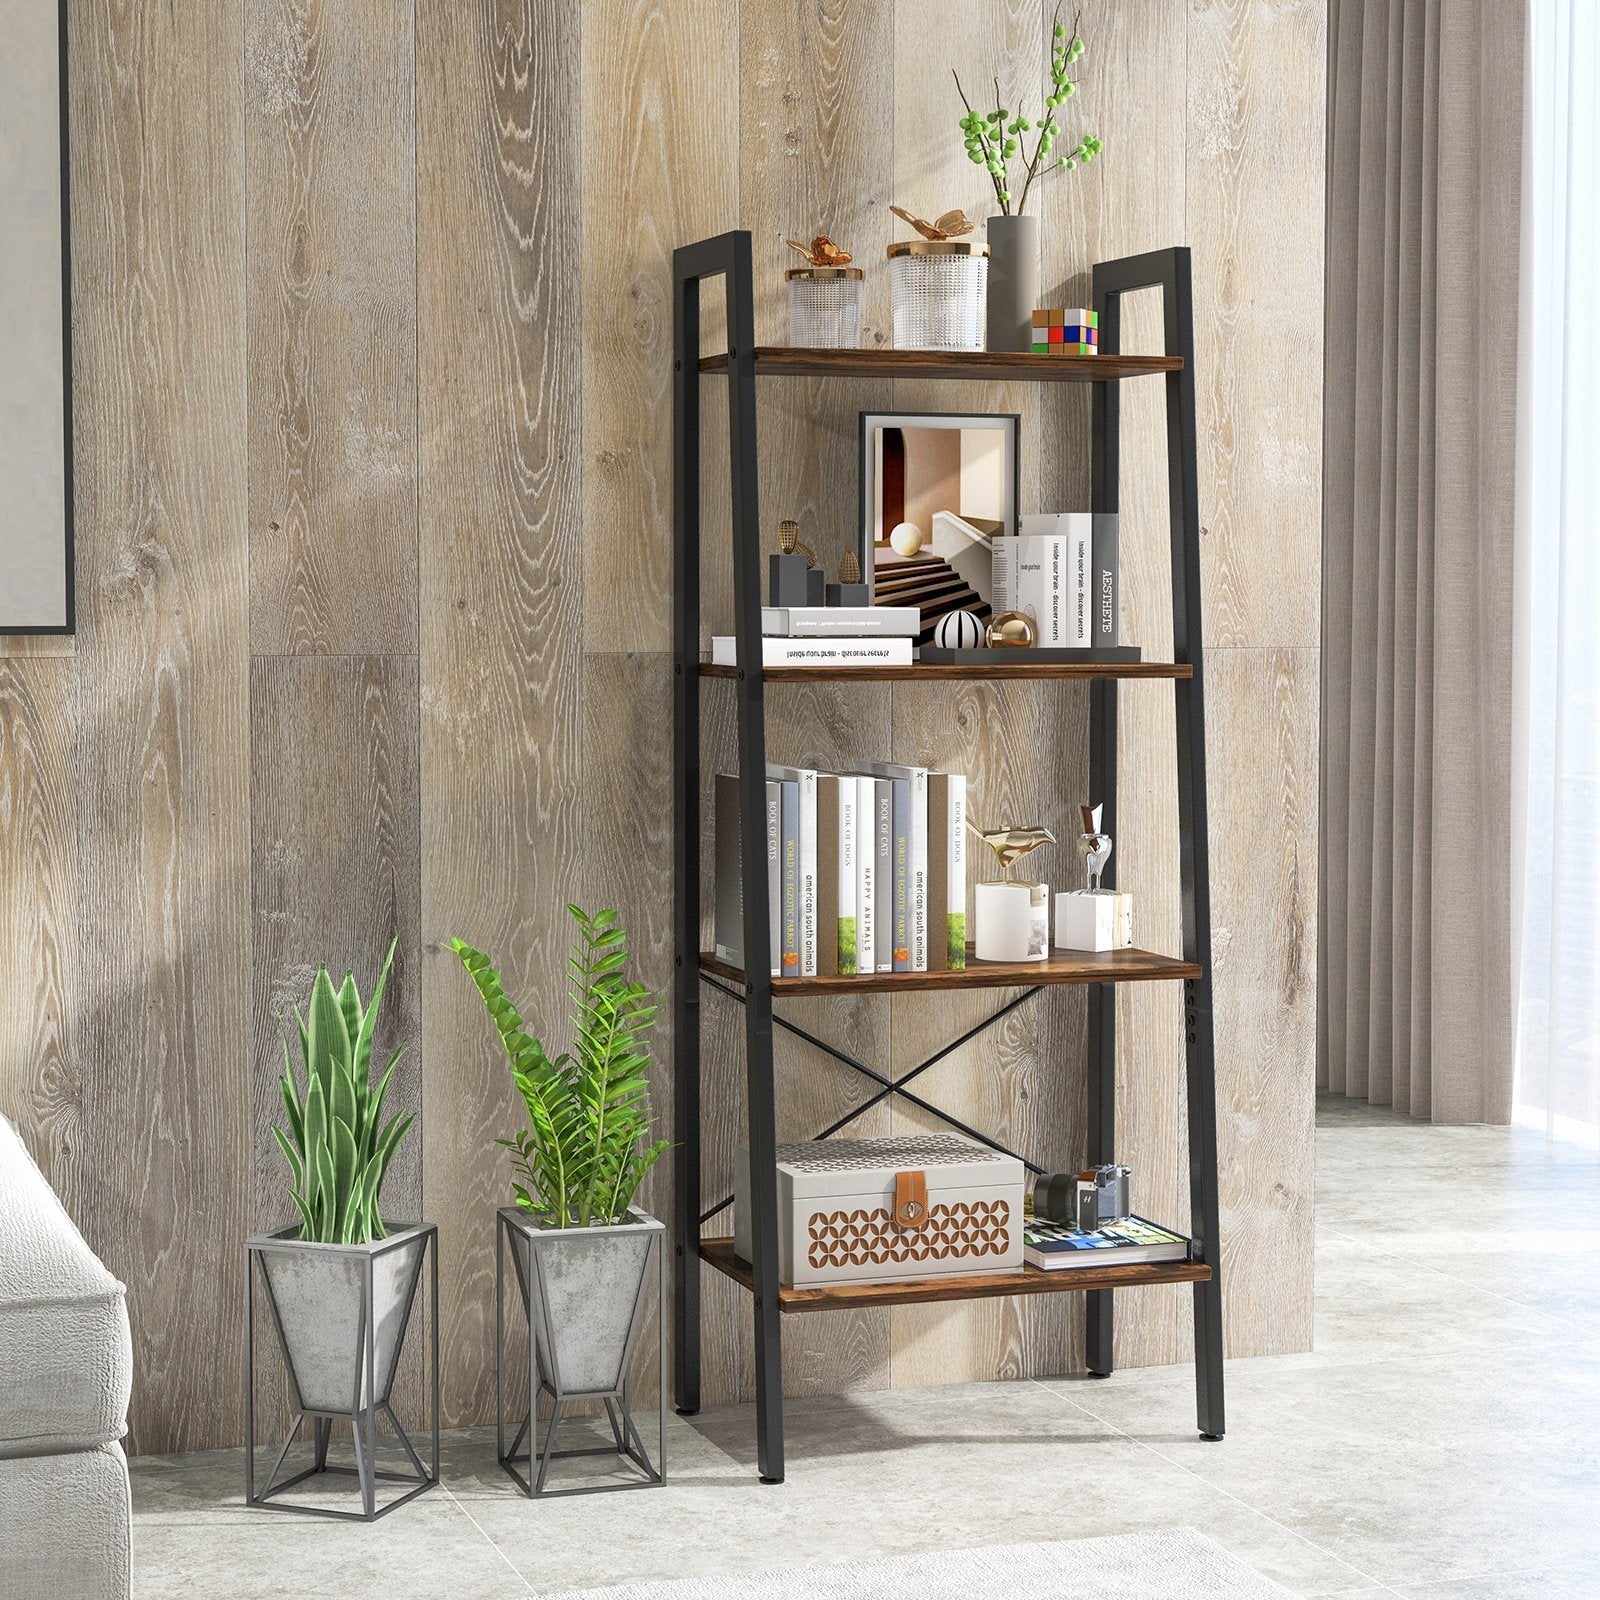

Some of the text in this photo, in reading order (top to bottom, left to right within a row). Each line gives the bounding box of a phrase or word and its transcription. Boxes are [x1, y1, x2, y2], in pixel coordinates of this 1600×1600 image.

[1102, 569, 1113, 633] AESTHETE
[768, 801, 777, 860] BOOK OF CATS
[844, 830, 851, 839] OF
[880, 798, 889, 857] BOOK OF CATS
[954, 827, 961, 836] OF
[787, 869, 794, 880] OF
[897, 866, 905, 877] OF
[786, 919, 794, 948] PARROT
[805, 874, 814, 973] american south animals
[897, 916, 905, 944] PARROT
[916, 871, 924, 968] american south animals
